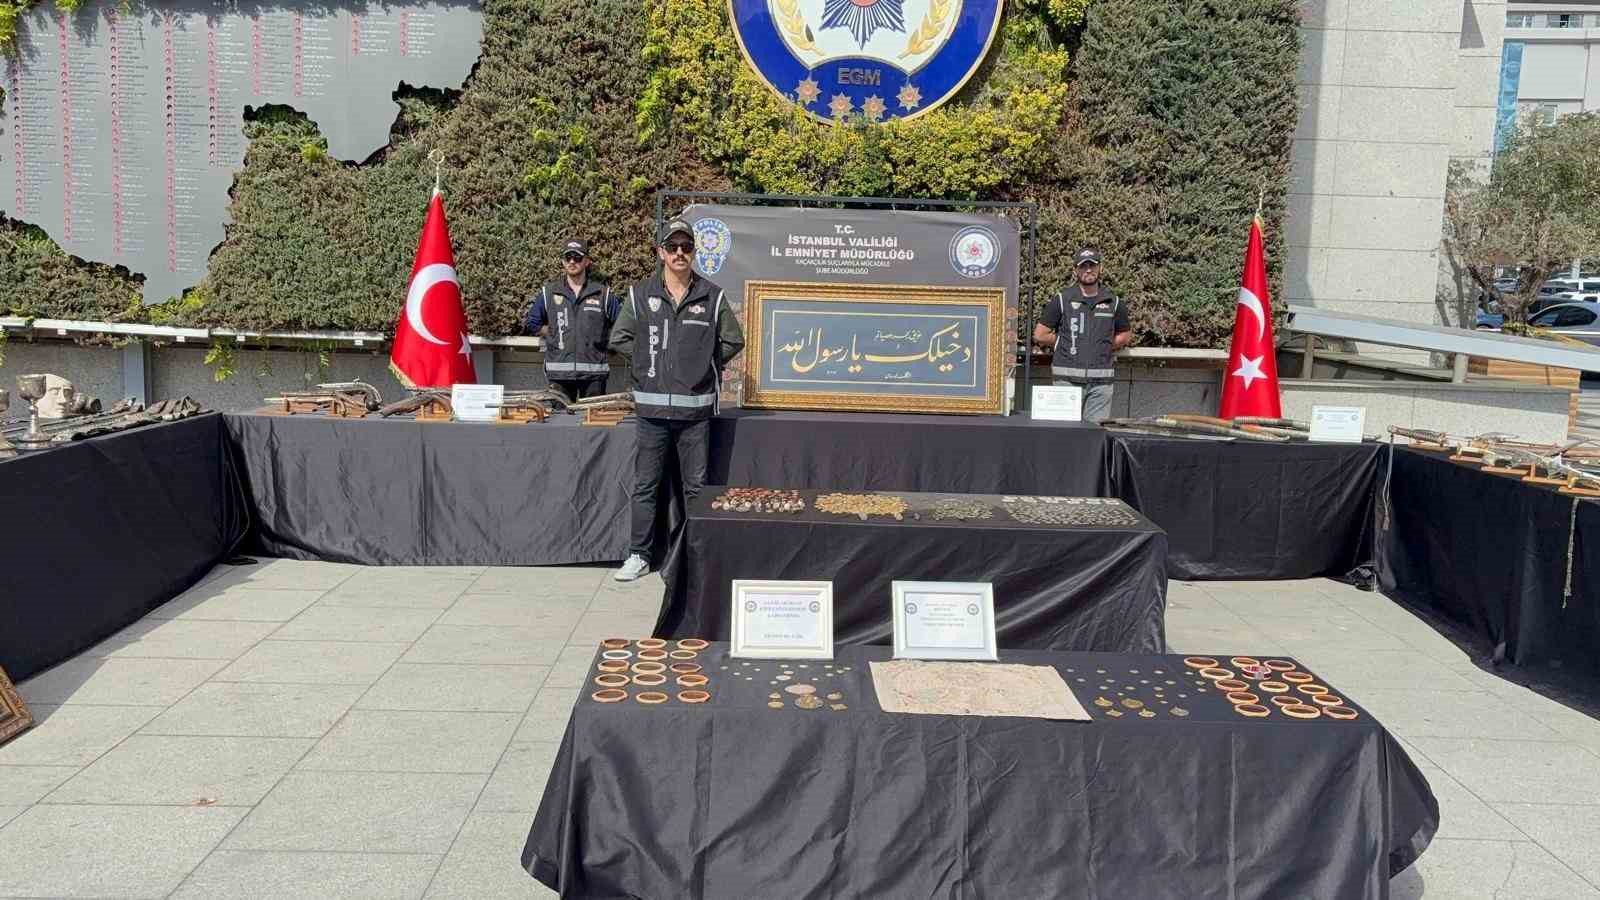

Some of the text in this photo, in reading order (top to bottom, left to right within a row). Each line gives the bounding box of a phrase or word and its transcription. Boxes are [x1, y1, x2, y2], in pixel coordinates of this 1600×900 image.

[838, 67, 881, 86] EGM
[834, 224, 856, 234] T.C.
[788, 234, 898, 248] İSTANBUL VALİLİĞİ
[771, 245, 915, 261] İL EMNİYET MÜDÜRLÜĞÜ
[647, 325, 660, 378] POLİS
